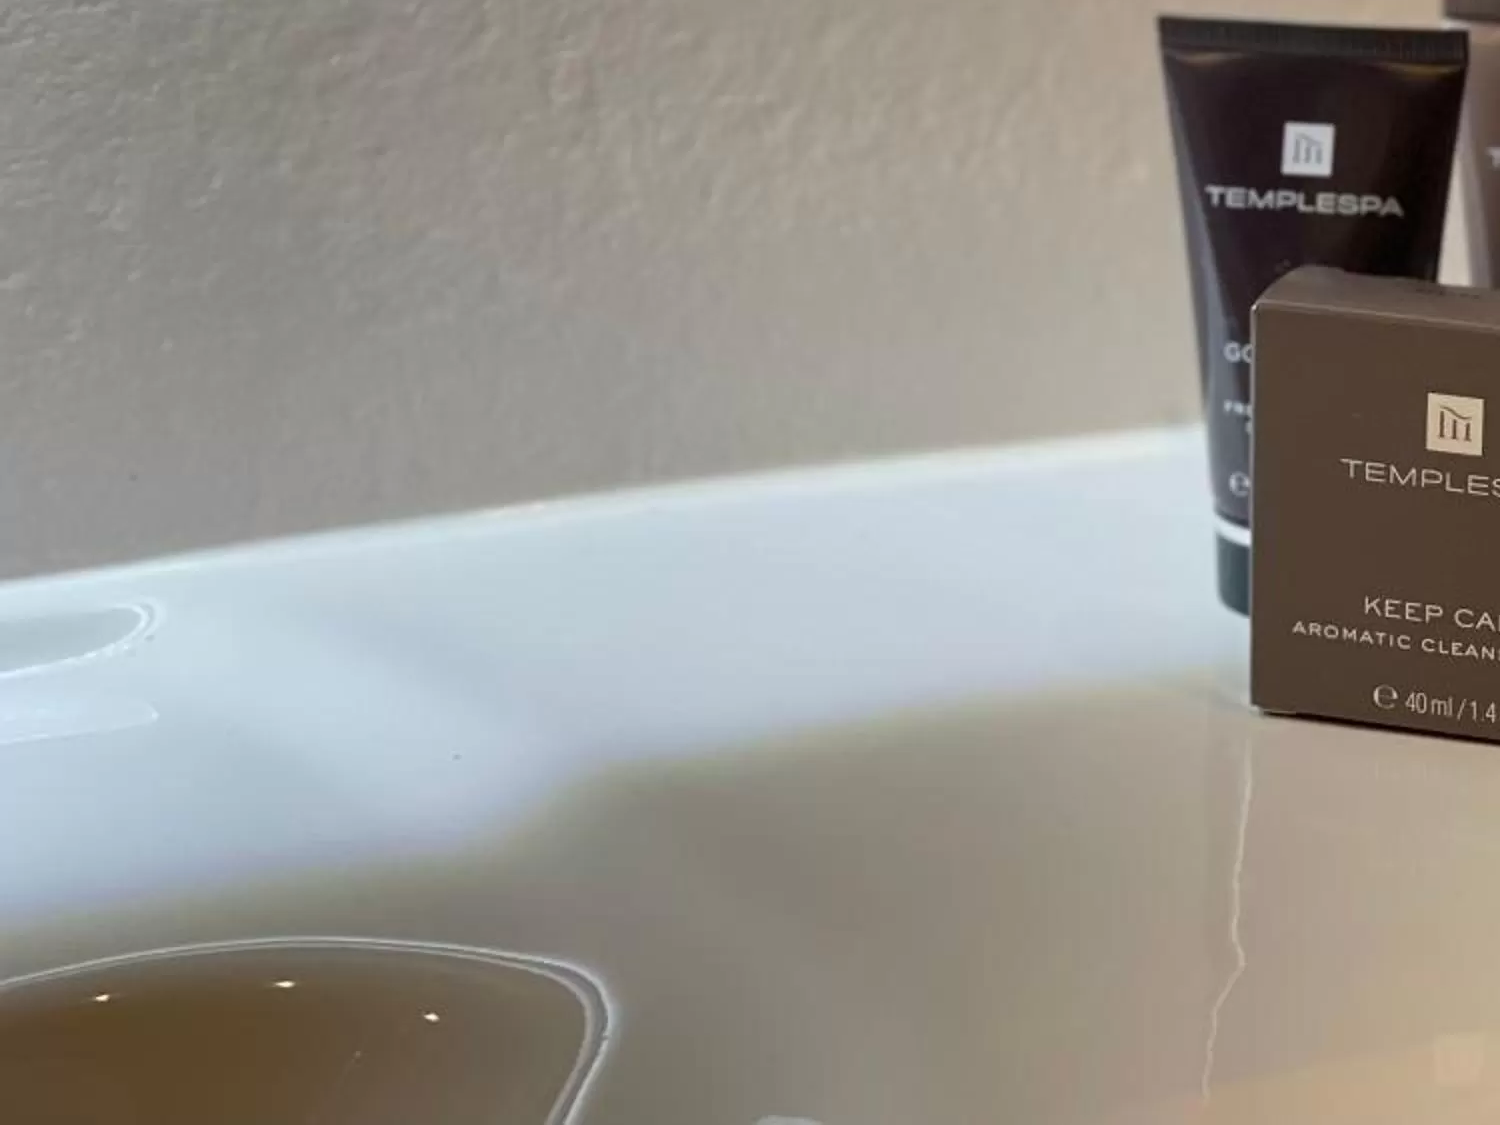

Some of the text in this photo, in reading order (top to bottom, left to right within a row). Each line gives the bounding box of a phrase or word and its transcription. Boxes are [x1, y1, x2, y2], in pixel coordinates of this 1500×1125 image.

[1204, 184, 1404, 217] TEMPLESPA
[1364, 595, 1444, 623] KEEP
[1292, 620, 1411, 650] AROMATIC
